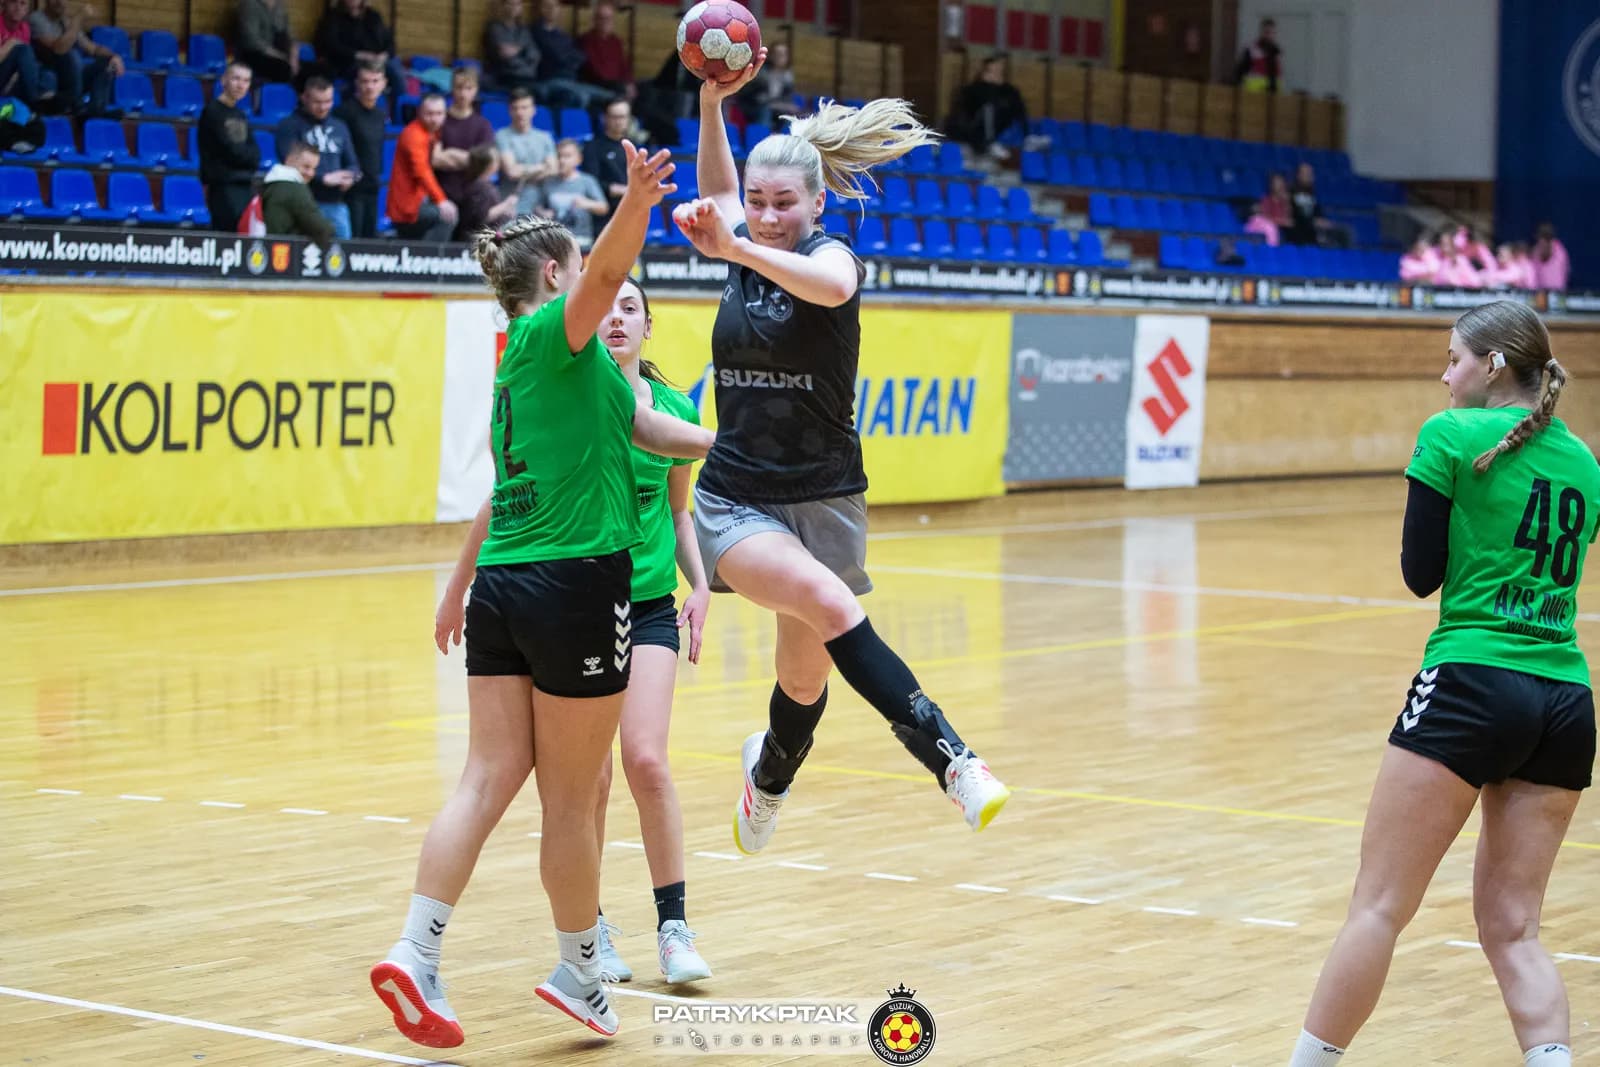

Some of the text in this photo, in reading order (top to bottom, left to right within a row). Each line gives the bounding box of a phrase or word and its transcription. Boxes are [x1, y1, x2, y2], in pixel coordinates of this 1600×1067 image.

[720, 368, 814, 391] SUZUKI
[81, 380, 396, 455] KOLPORTER
[1513, 476, 1586, 588] 48
[1493, 583, 1535, 620] AZS
